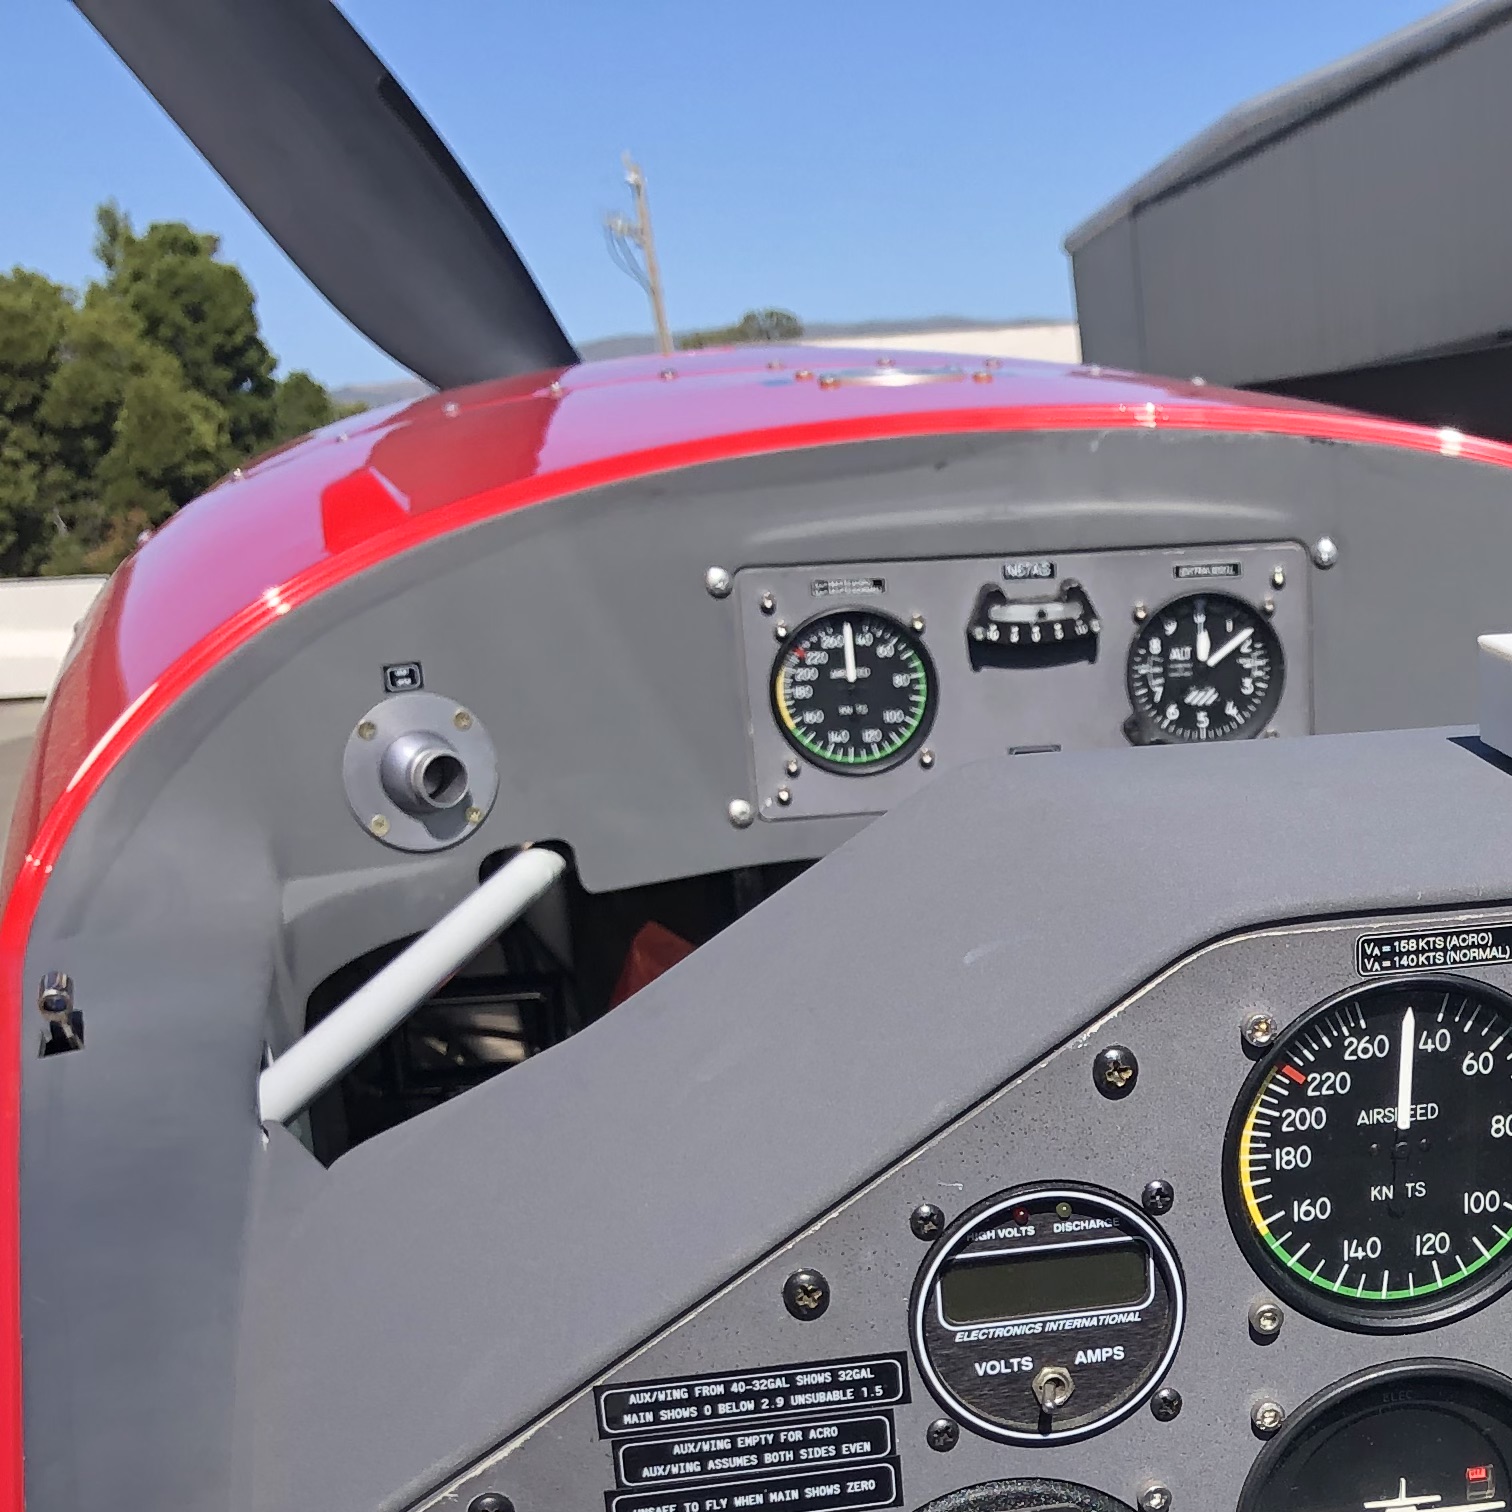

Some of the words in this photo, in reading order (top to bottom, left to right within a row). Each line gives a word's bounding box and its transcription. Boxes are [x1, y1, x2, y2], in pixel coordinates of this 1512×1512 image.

[805, 650, 829, 665] 220
[1241, 677, 1254, 695] 3
[883, 709, 904, 723] 100
[1166, 703, 1179, 720] 6
[1196, 711, 1209, 728] 5
[1394, 940, 1417, 952] 158
[1419, 937, 1444, 950] KTS
[1446, 932, 1492, 949] (ACRO)
[1394, 955, 1417, 967] 140
[1419, 952, 1444, 965] KTS
[1446, 946, 1510, 964] (NORMAL)
[1344, 1035, 1389, 1061] 260
[1419, 1029, 1451, 1052] 40
[1462, 1052, 1494, 1076] 60
[1307, 1073, 1351, 1095] 220
[1281, 1107, 1327, 1131] 200
[1275, 1146, 1312, 1170] 180
[1293, 1197, 1331, 1222] 160
[1463, 1192, 1500, 1214] 100
[998, 1226, 1035, 1238] VOLTS
[1054, 1218, 1120, 1233] DISCHARGE
[1343, 1237, 1381, 1260] 140
[1416, 1233, 1450, 1255] 120
[955, 1323, 1042, 1342] ELECTRONICS
[1045, 1312, 1141, 1332] INTERNATIONAL
[1075, 1346, 1125, 1364] AMPS
[975, 1357, 1033, 1376] VOLTS
[629, 1387, 689, 1405] AUX/WING
[695, 1384, 725, 1397] FROM
[731, 1377, 790, 1394] 40-32GAL
[796, 1372, 832, 1386] SHOWS
[838, 1368, 874, 1381] 32GAL
[624, 1413, 653, 1426] MAIN
[660, 1406, 698, 1420] SHOWS
[718, 1401, 754, 1414] BELOW
[761, 1397, 784, 1409] 2.9
[791, 1388, 855, 1405] UNSUBABLE
[861, 1386, 883, 1398] 1.5
[673, 1438, 731, 1455] AUX/WING
[737, 1433, 774, 1447] EMPTY
[780, 1430, 803, 1443] FOR
[809, 1426, 838, 1439] ACRO
[642, 1460, 701, 1478] AUX/WING
[708, 1455, 758, 1470] ASSUMES
[765, 1450, 794, 1464] BOTH
[800, 1446, 836, 1460] SIDES
[842, 1442, 870, 1455] EVEN
[684, 1502, 699, 1512] TO
[706, 1498, 727, 1511] FLY
[734, 1493, 763, 1508] WHEN
[769, 1489, 798, 1503] MAIN
[804, 1484, 840, 1498] SHOWS
[847, 1479, 875, 1492] ZERO
